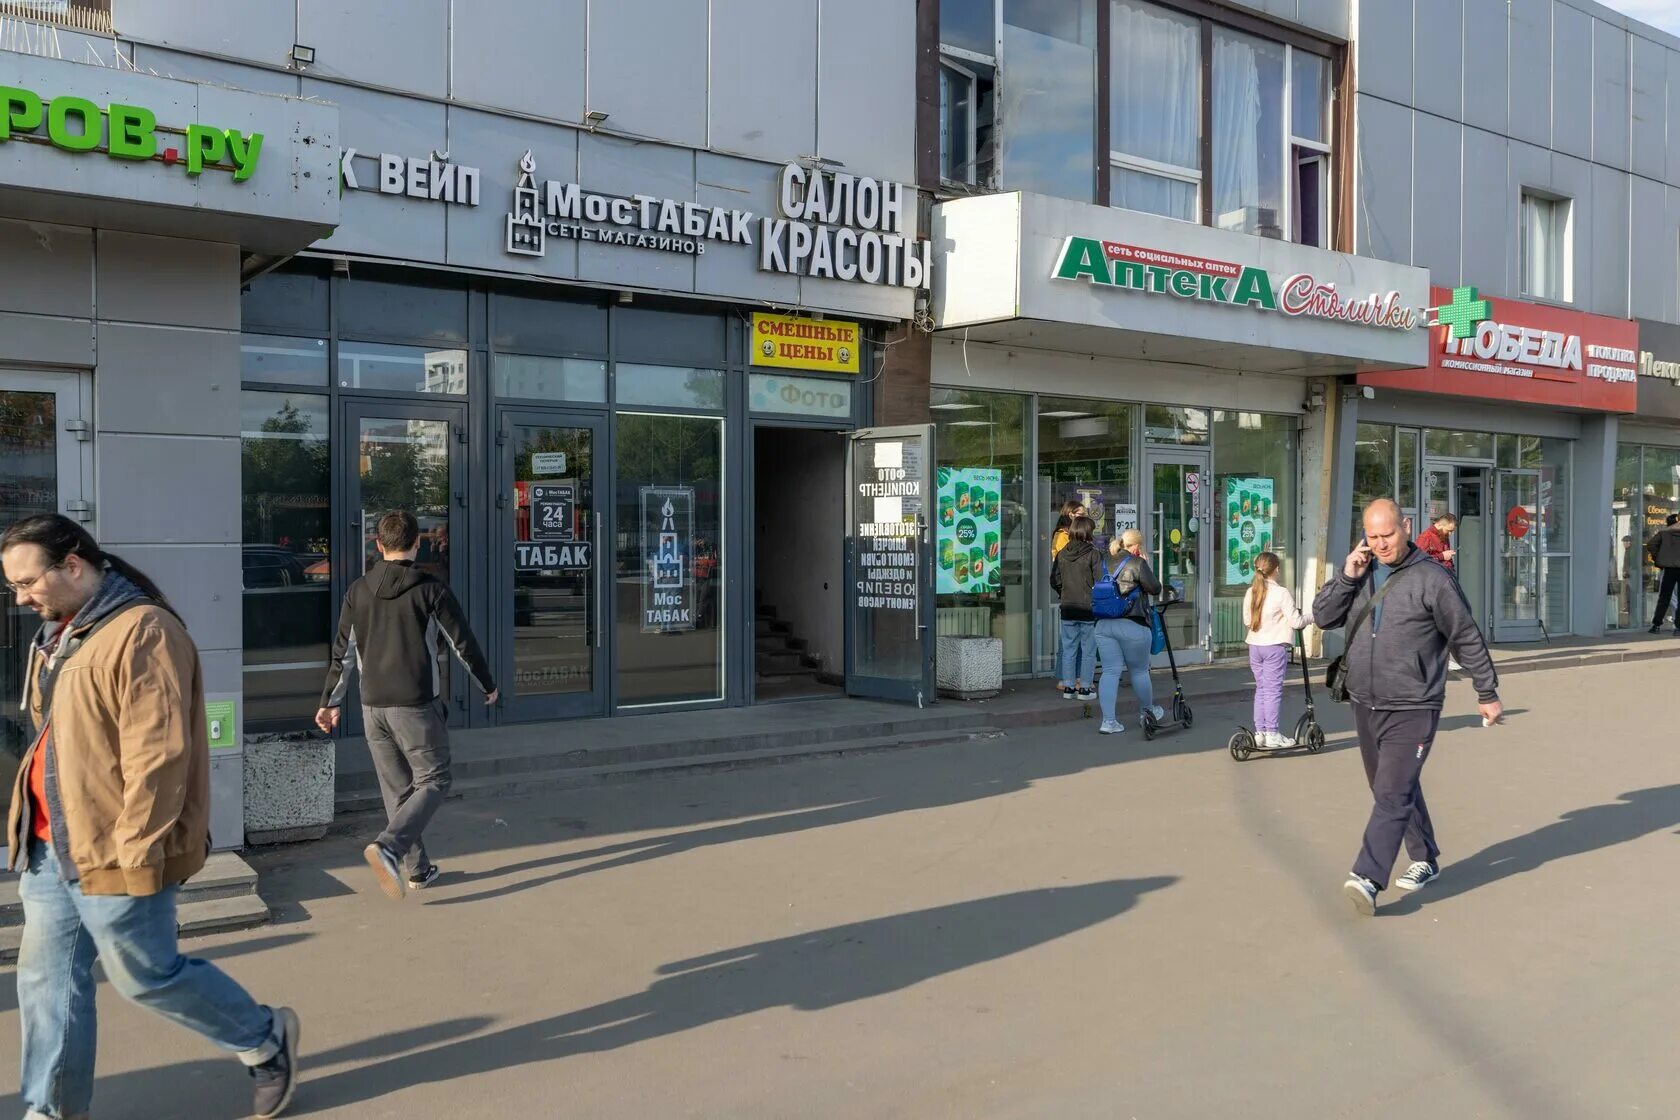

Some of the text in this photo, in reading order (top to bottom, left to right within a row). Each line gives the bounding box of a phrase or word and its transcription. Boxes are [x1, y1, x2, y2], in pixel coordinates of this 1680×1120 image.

[380, 149, 480, 206] ВЕЙП
[778, 161, 903, 234] САЛОН
[548, 221, 706, 255] СЕТЬ МАГАЗИНОВ
[760, 216, 931, 290] КРАСОТЫ
[1107, 243, 1238, 275] сеть социальных аптек
[1279, 273, 1418, 331] Столички
[757, 319, 855, 343] СМЕШНЫЕ
[779, 342, 834, 362] ЦЕНЫ
[1587, 344, 1636, 364] ПОКУПКА
[1586, 363, 1637, 383] ПРОДАЖА
[1638, 350, 1680, 386] Пека
[542, 506, 563, 521] 24
[542, 520, 563, 528] часа
[958, 529, 975, 538] 25%
[1242, 530, 1254, 538] 25%
[517, 545, 588, 567] ТАБАК
[654, 592, 682, 606] Мос
[647, 608, 690, 623] ТАБАК
